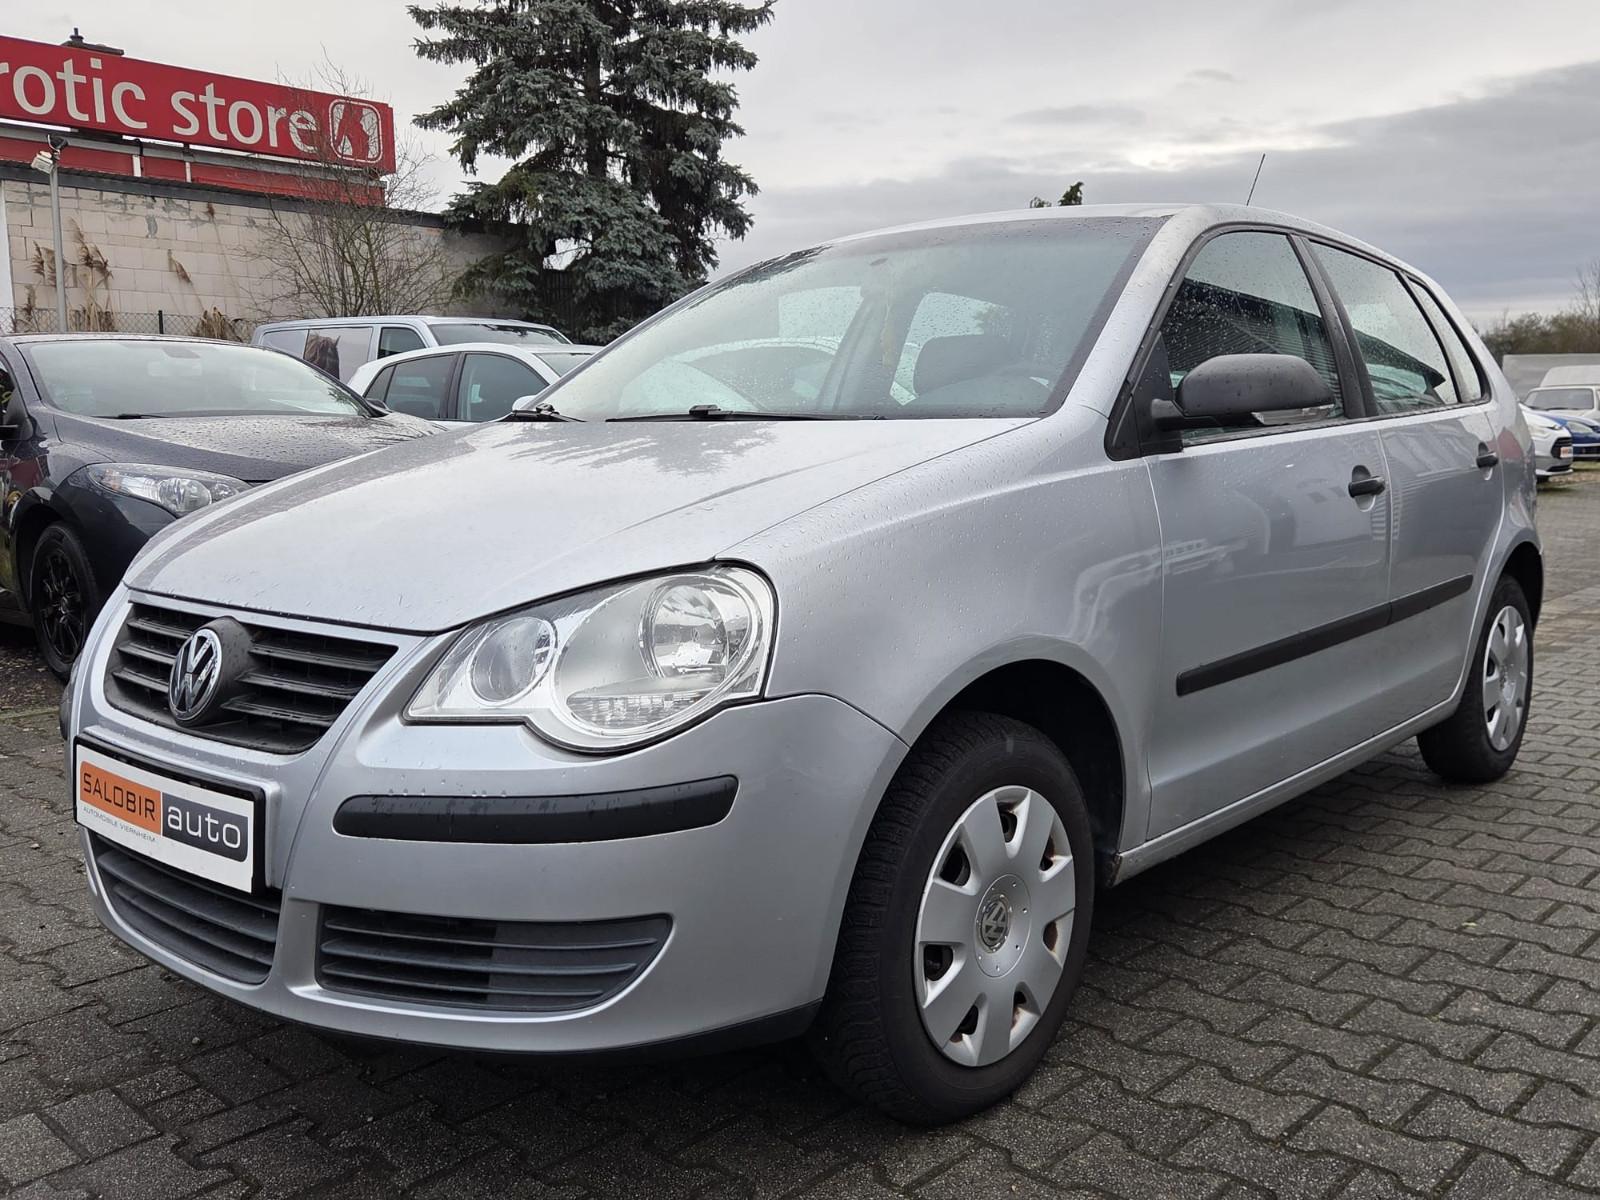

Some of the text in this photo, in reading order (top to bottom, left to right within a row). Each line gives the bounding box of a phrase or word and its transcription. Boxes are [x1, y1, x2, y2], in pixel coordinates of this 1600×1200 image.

[170, 82, 319, 154] store
[171, 630, 220, 718] VW
[83, 772, 241, 849] SALOBIR auto
